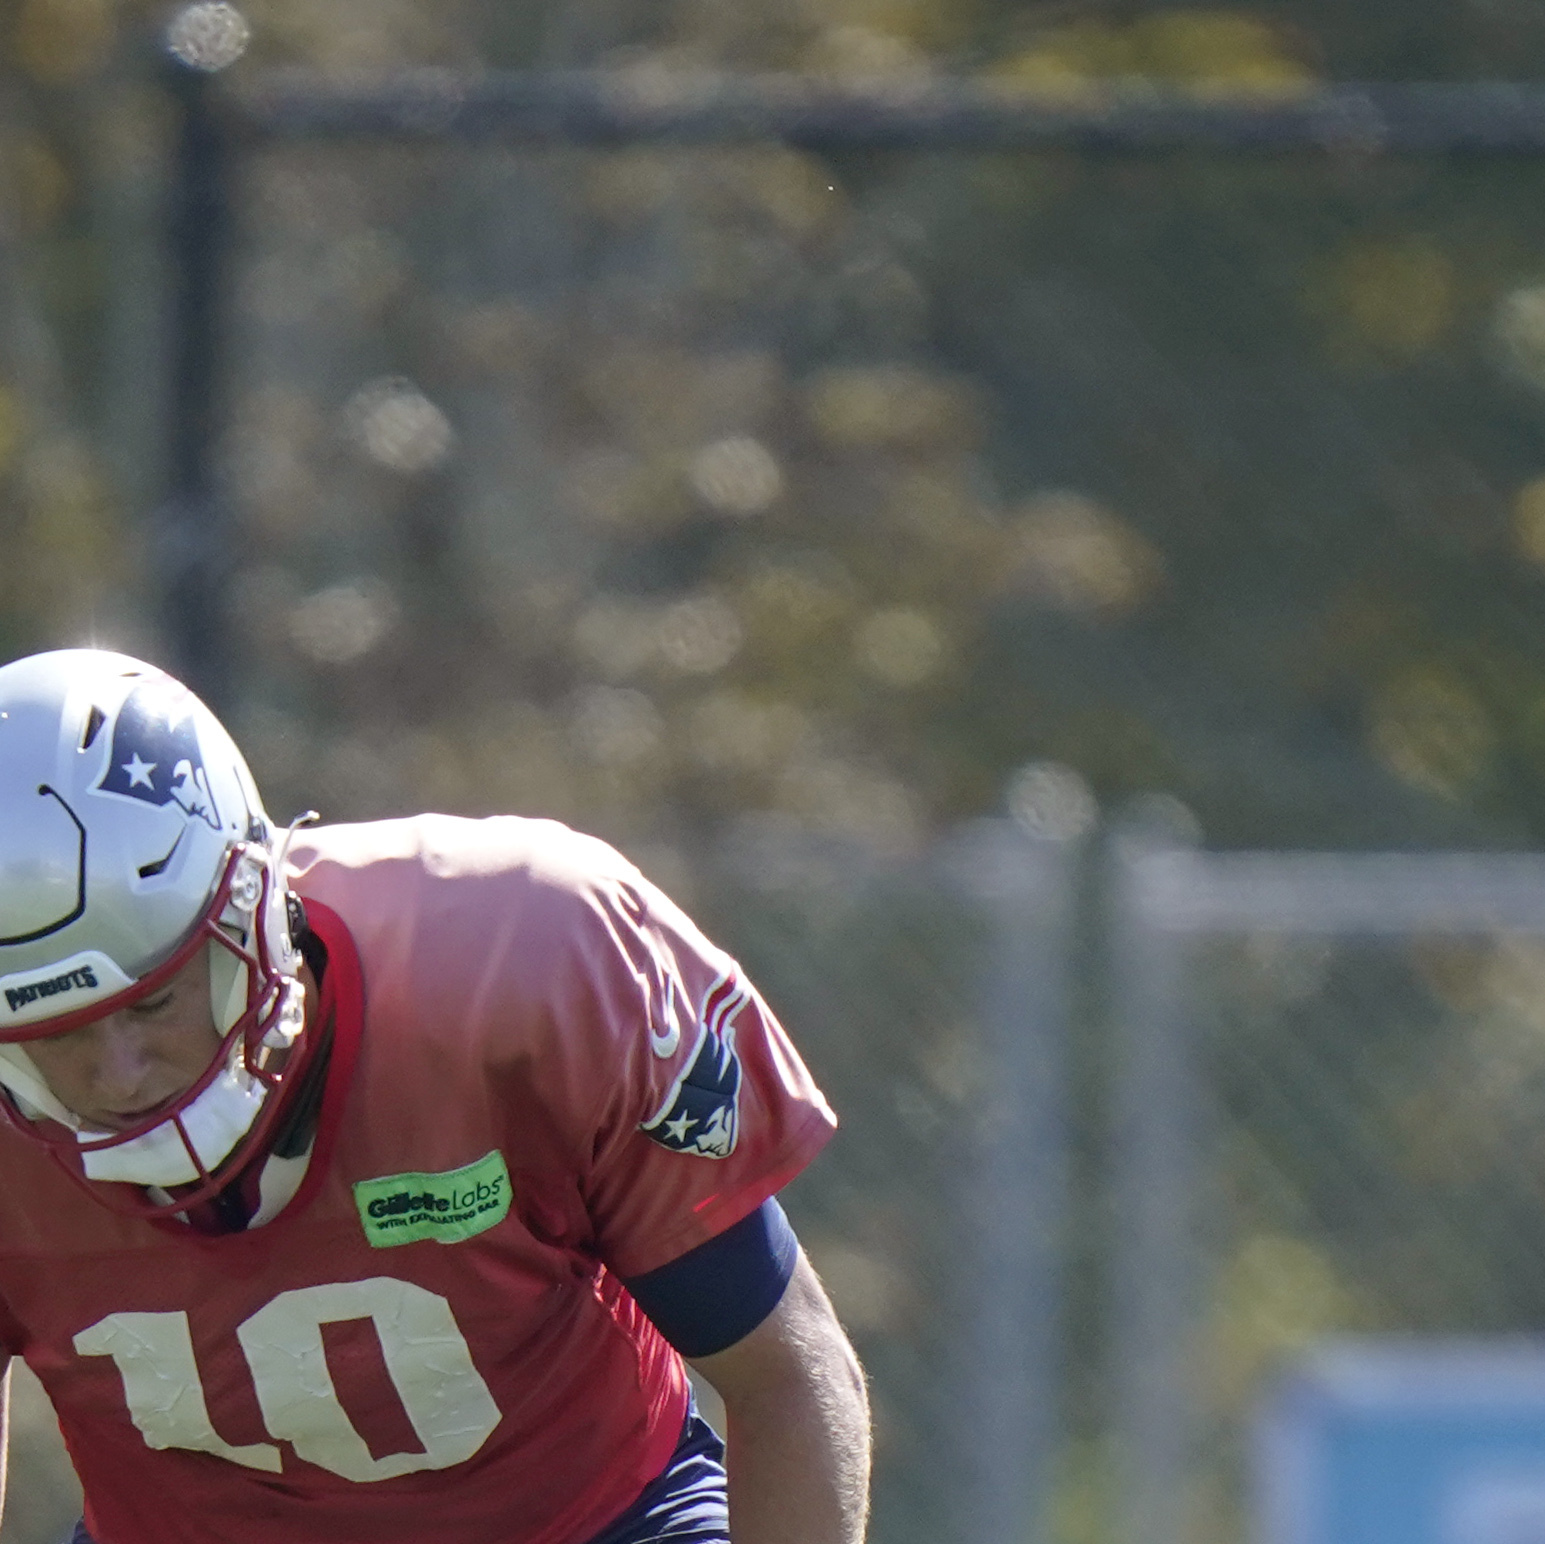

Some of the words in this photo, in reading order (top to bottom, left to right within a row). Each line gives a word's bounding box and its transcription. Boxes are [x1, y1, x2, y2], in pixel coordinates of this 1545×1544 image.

[4, 964, 98, 1011] PATRIOTS
[375, 1218, 408, 1230] WITH
[478, 1199, 500, 1212] BAR
[72, 1276, 503, 1483] 10
